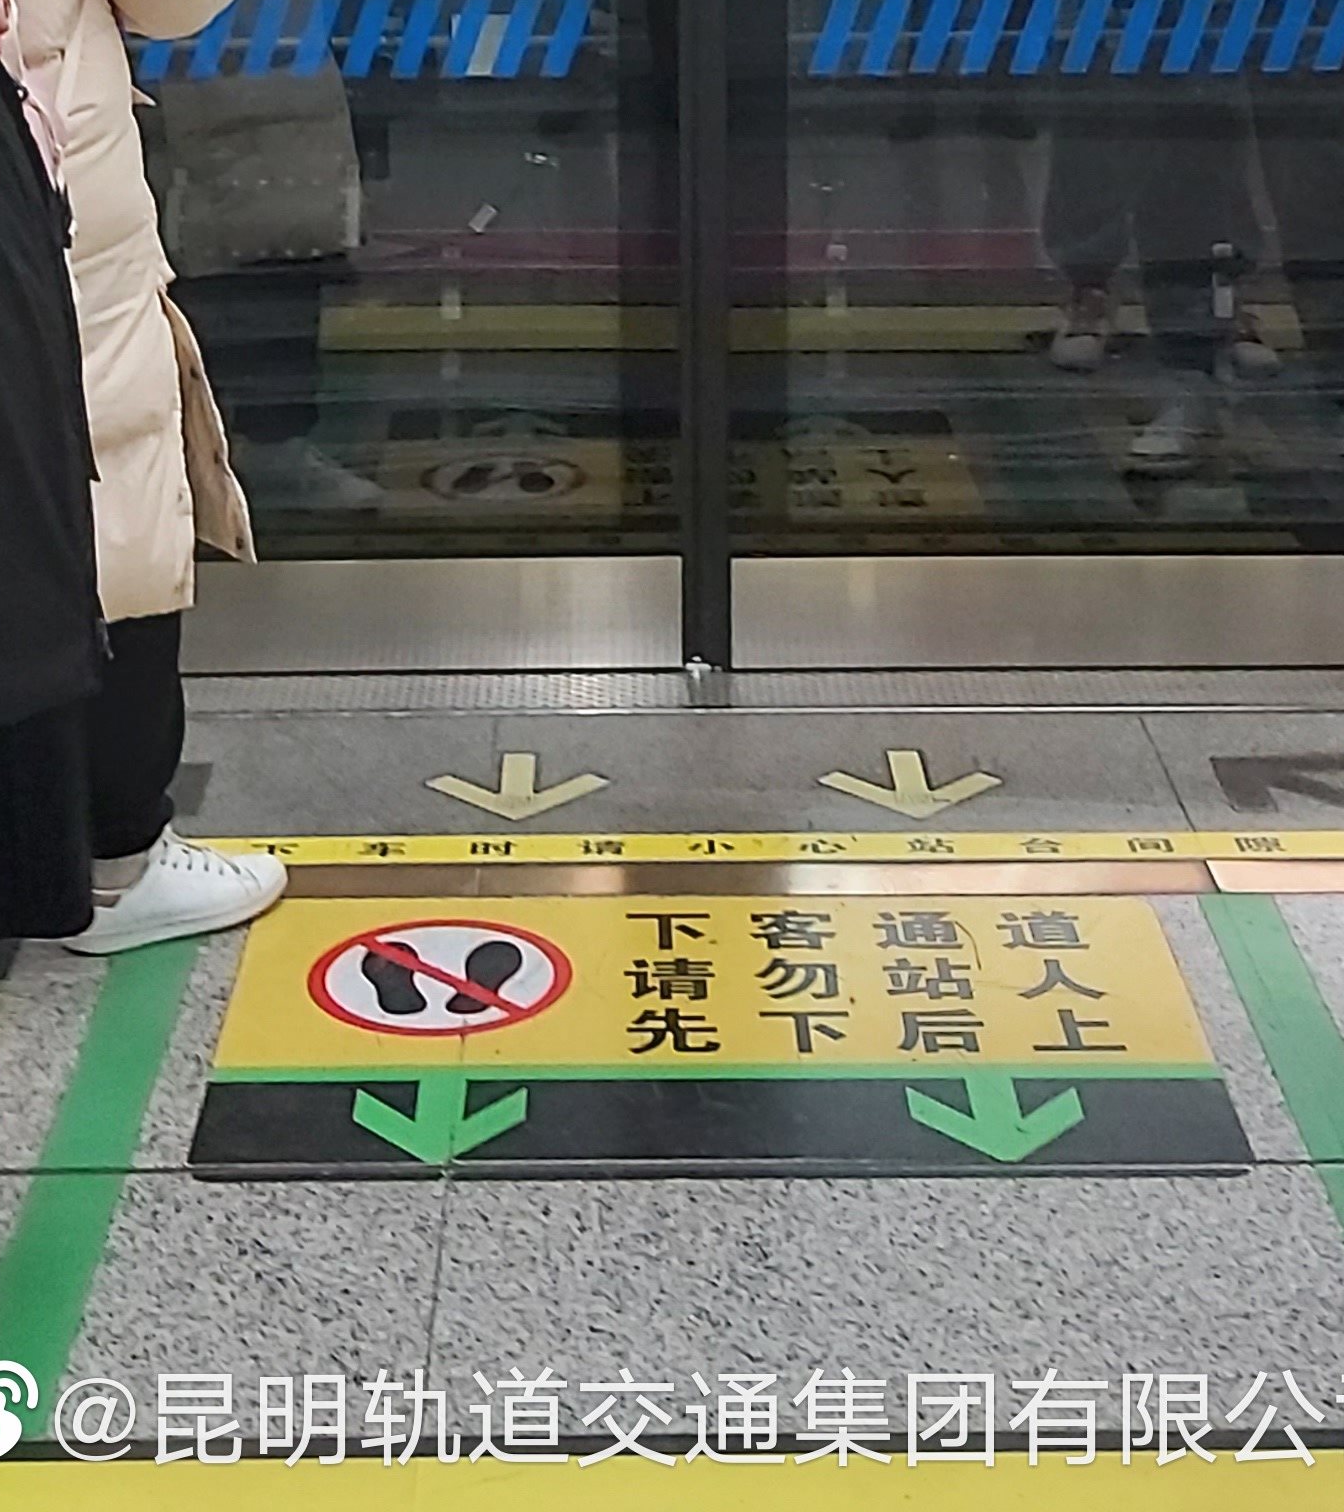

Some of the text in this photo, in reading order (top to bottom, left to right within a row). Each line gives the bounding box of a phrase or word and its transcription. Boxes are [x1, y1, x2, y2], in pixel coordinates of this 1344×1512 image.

[626, 910, 1090, 950] 下客通道
[623, 957, 1108, 1000] 请勿站人
[625, 1006, 1128, 1054] 先下后上
